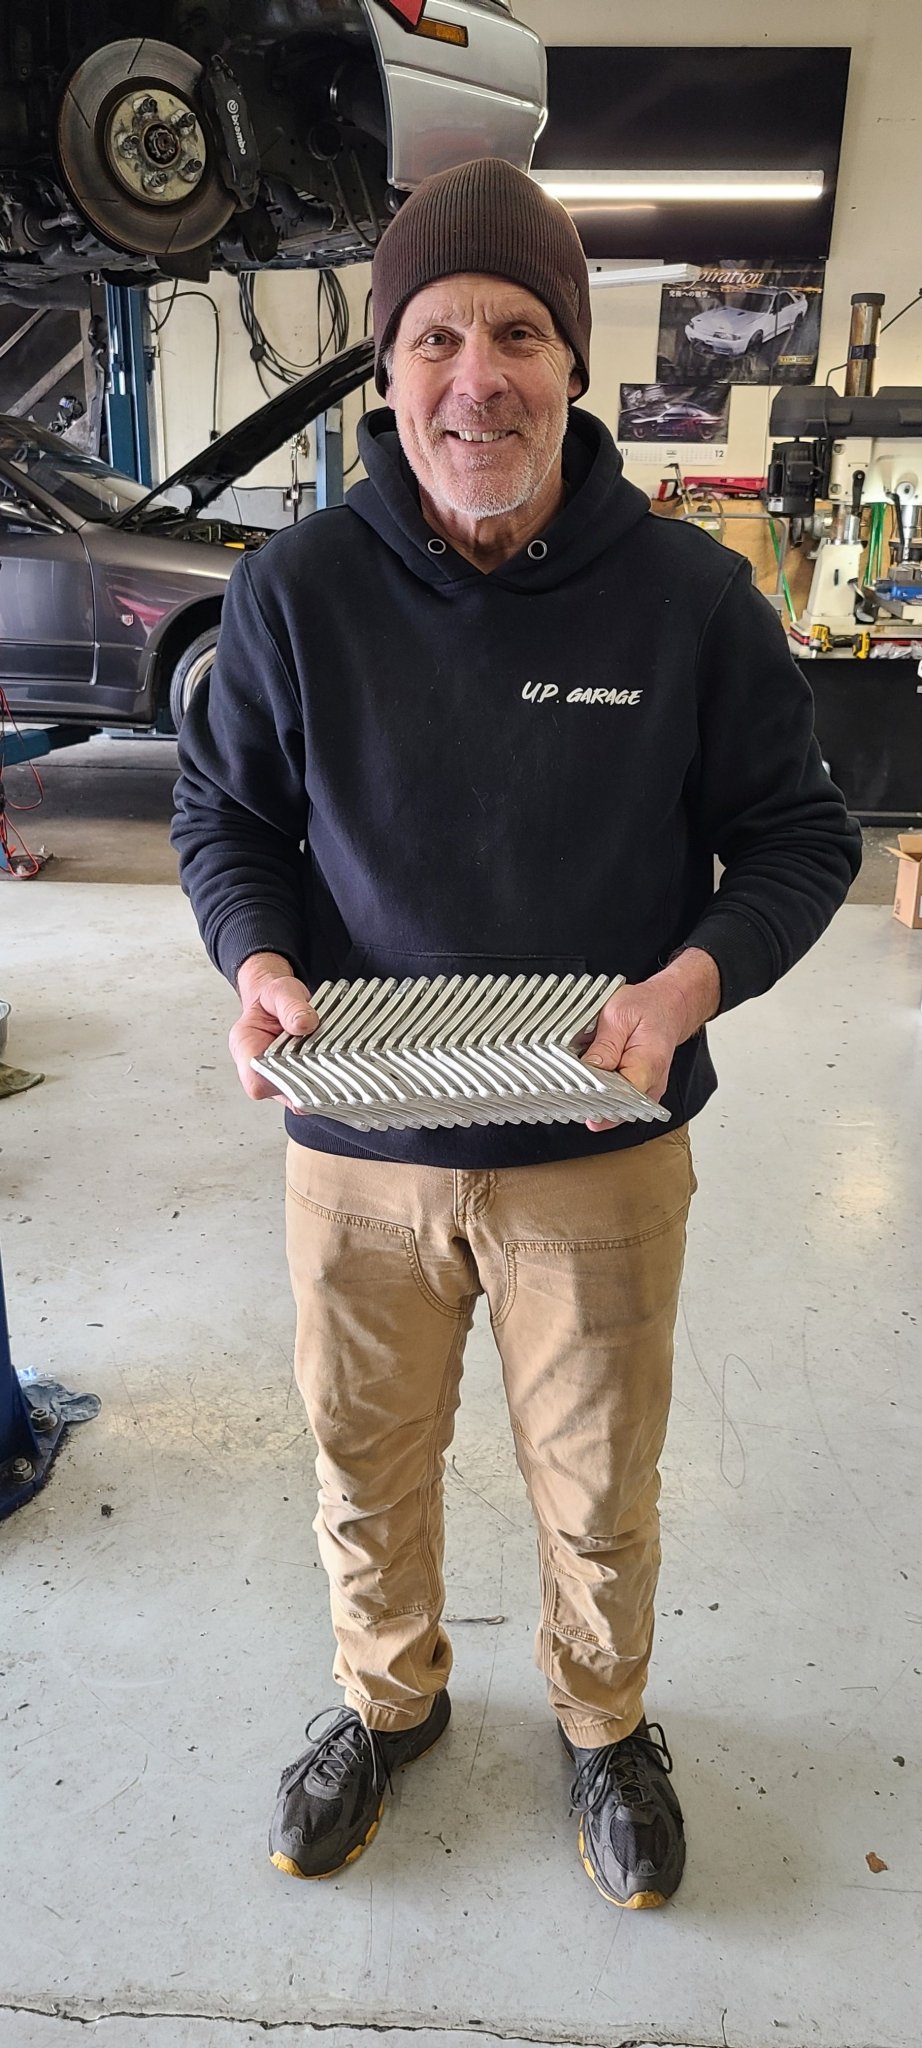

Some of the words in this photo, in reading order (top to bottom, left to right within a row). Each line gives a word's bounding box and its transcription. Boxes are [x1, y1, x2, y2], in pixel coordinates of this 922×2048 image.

[231, 114, 246, 155] brembo
[683, 267, 765, 290] piration
[715, 450, 724, 458] 12
[566, 687, 643, 705] GARAGE
